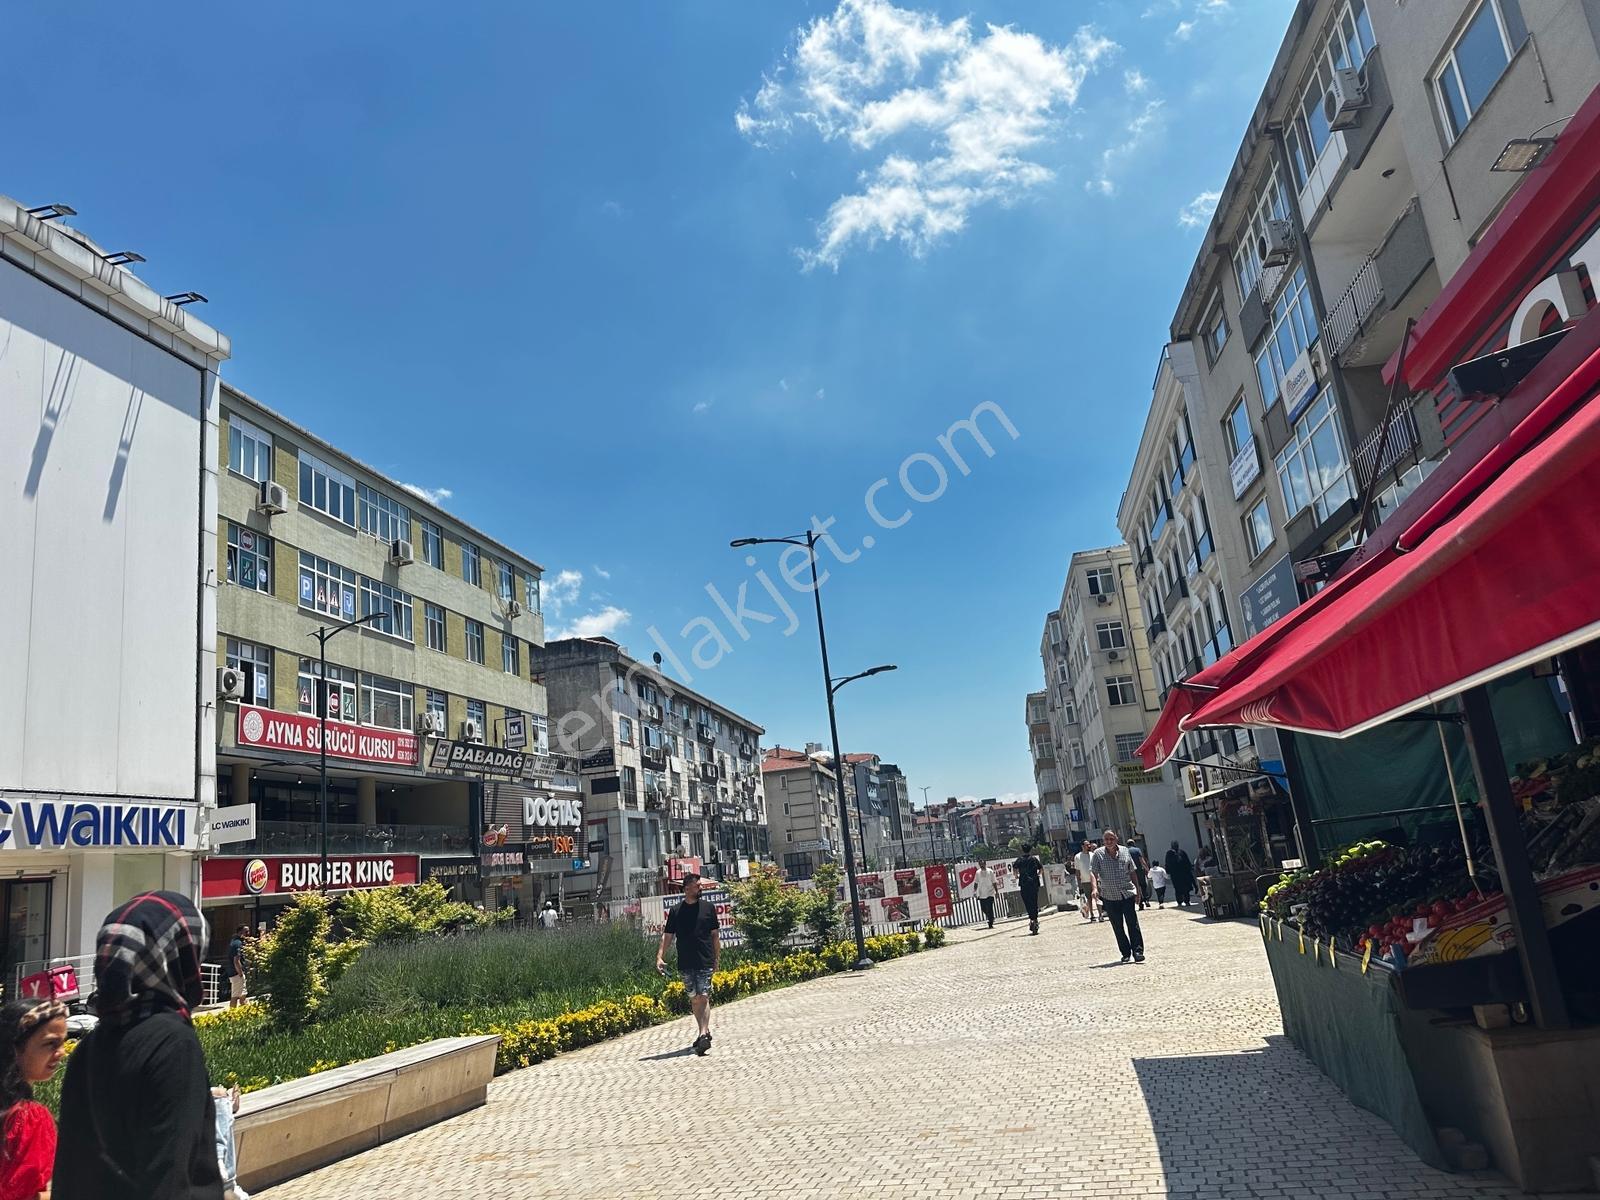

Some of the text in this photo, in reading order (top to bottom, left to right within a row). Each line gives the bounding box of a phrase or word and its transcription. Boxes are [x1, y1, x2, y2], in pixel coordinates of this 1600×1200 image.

[266, 720, 395, 760] AYNA SÜRÜCÜ KURSU
[452, 746, 523, 769] BABADAĞ
[522, 792, 583, 833] DOĞTAŞ
[211, 822, 221, 831] LC
[282, 859, 394, 888] BURGER KING
[430, 866, 458, 876] SAYDAM
